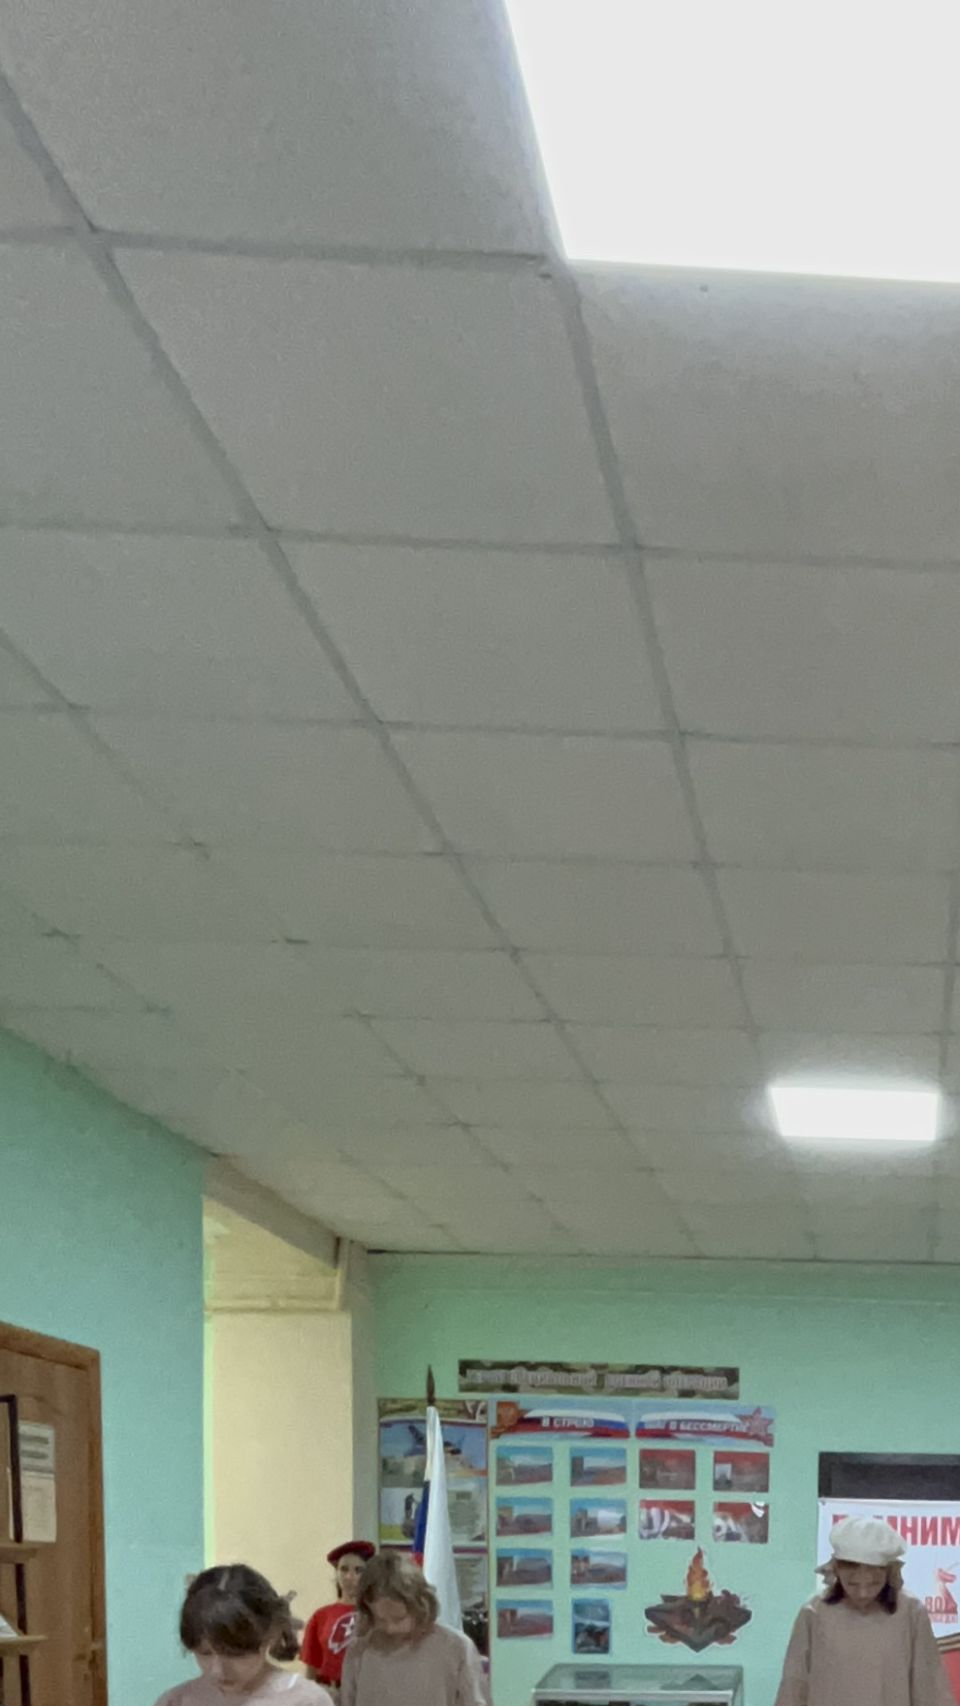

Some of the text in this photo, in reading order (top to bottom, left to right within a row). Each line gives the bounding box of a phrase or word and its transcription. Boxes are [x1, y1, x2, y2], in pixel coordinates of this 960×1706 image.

[542, 1416, 594, 1429] В СТРОЮ
[669, 1420, 677, 1431] В
